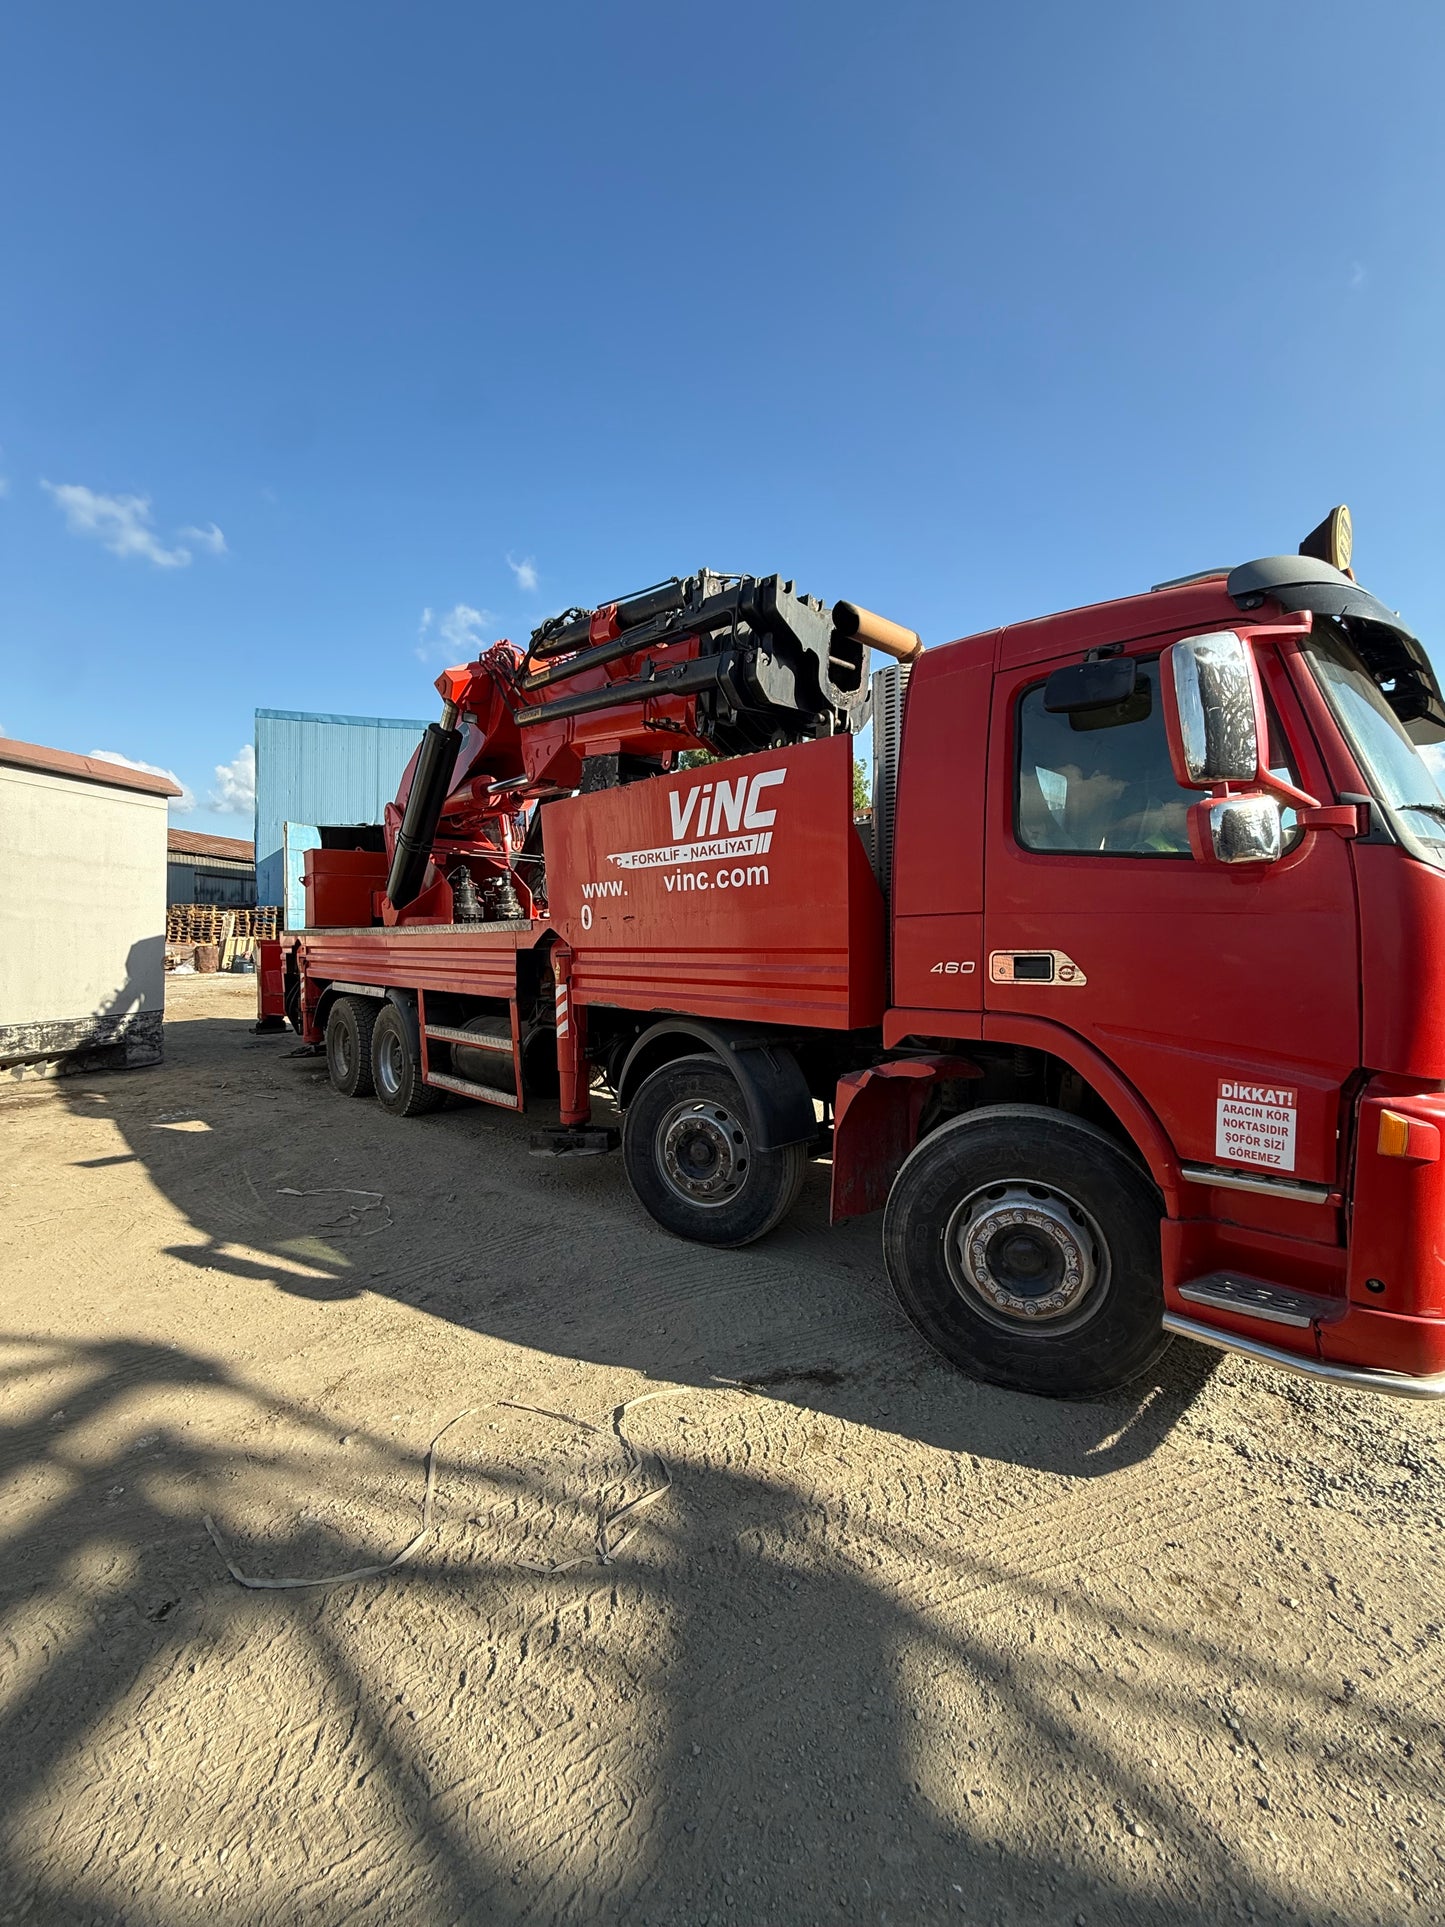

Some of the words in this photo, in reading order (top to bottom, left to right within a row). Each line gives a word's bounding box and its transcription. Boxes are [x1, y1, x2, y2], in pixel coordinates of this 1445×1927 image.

[690, 839, 754, 861] NAKLİYAT
[581, 880, 628, 899] www.
[664, 865, 769, 892] vinc.com
[930, 961, 976, 975] 460
[1221, 1082, 1293, 1106] DİKKAT!
[1222, 1103, 1263, 1118] ARACIN
[1266, 1109, 1290, 1122] KÖR
[1222, 1118, 1289, 1137] NOKTASIDIR
[1224, 1131, 1261, 1147] ŞOFÖR
[1263, 1137, 1286, 1151] SİZİ
[1228, 1145, 1281, 1165] GÖREMEZ
